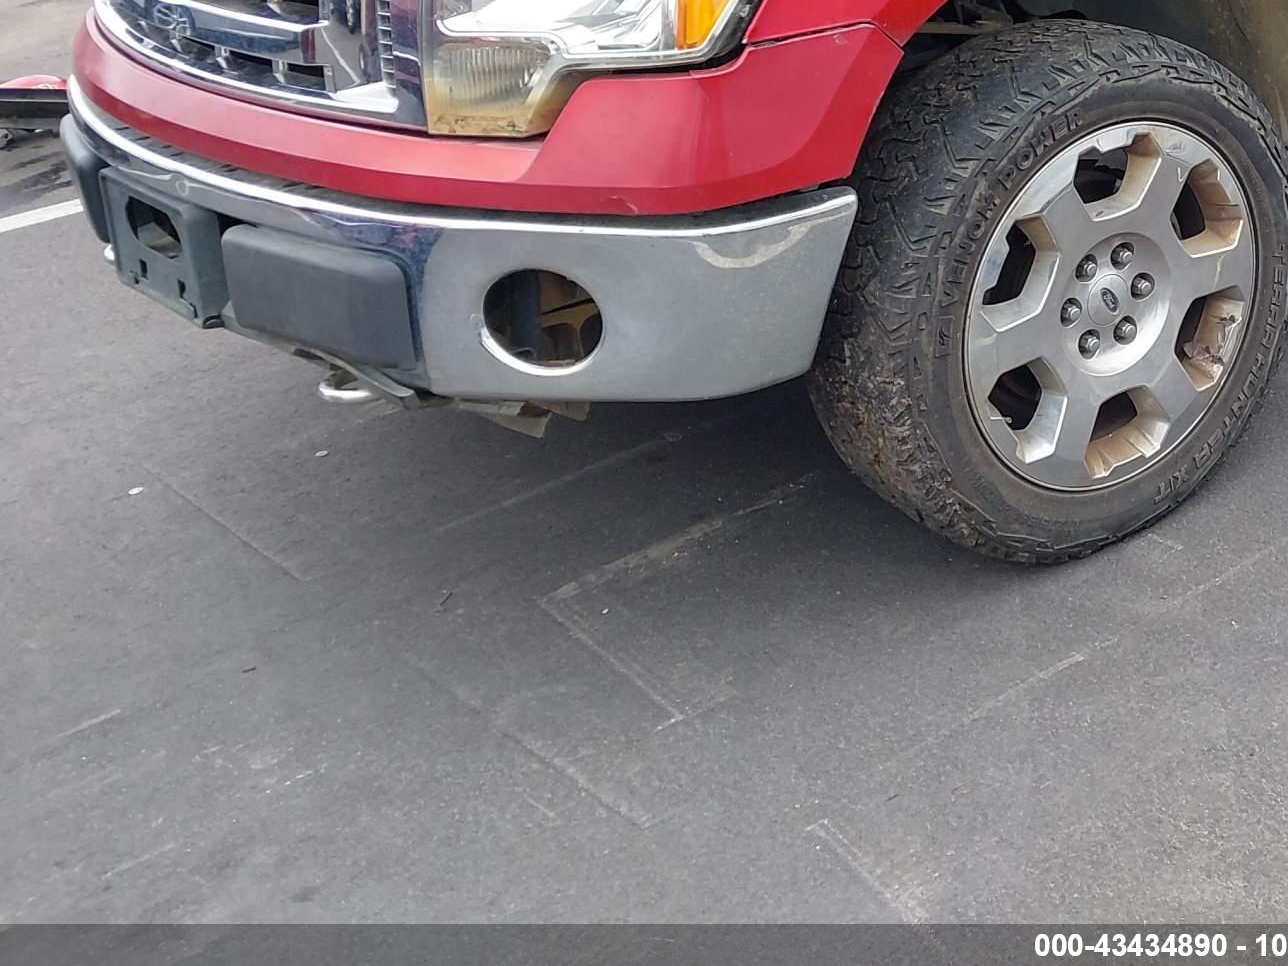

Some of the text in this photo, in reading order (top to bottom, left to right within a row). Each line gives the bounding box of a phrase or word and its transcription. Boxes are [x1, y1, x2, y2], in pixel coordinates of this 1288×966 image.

[941, 107, 1084, 308] VENOM POWER
[1261, 243, 1287, 349] TERRA
[1193, 352, 1265, 470] HUNTER
